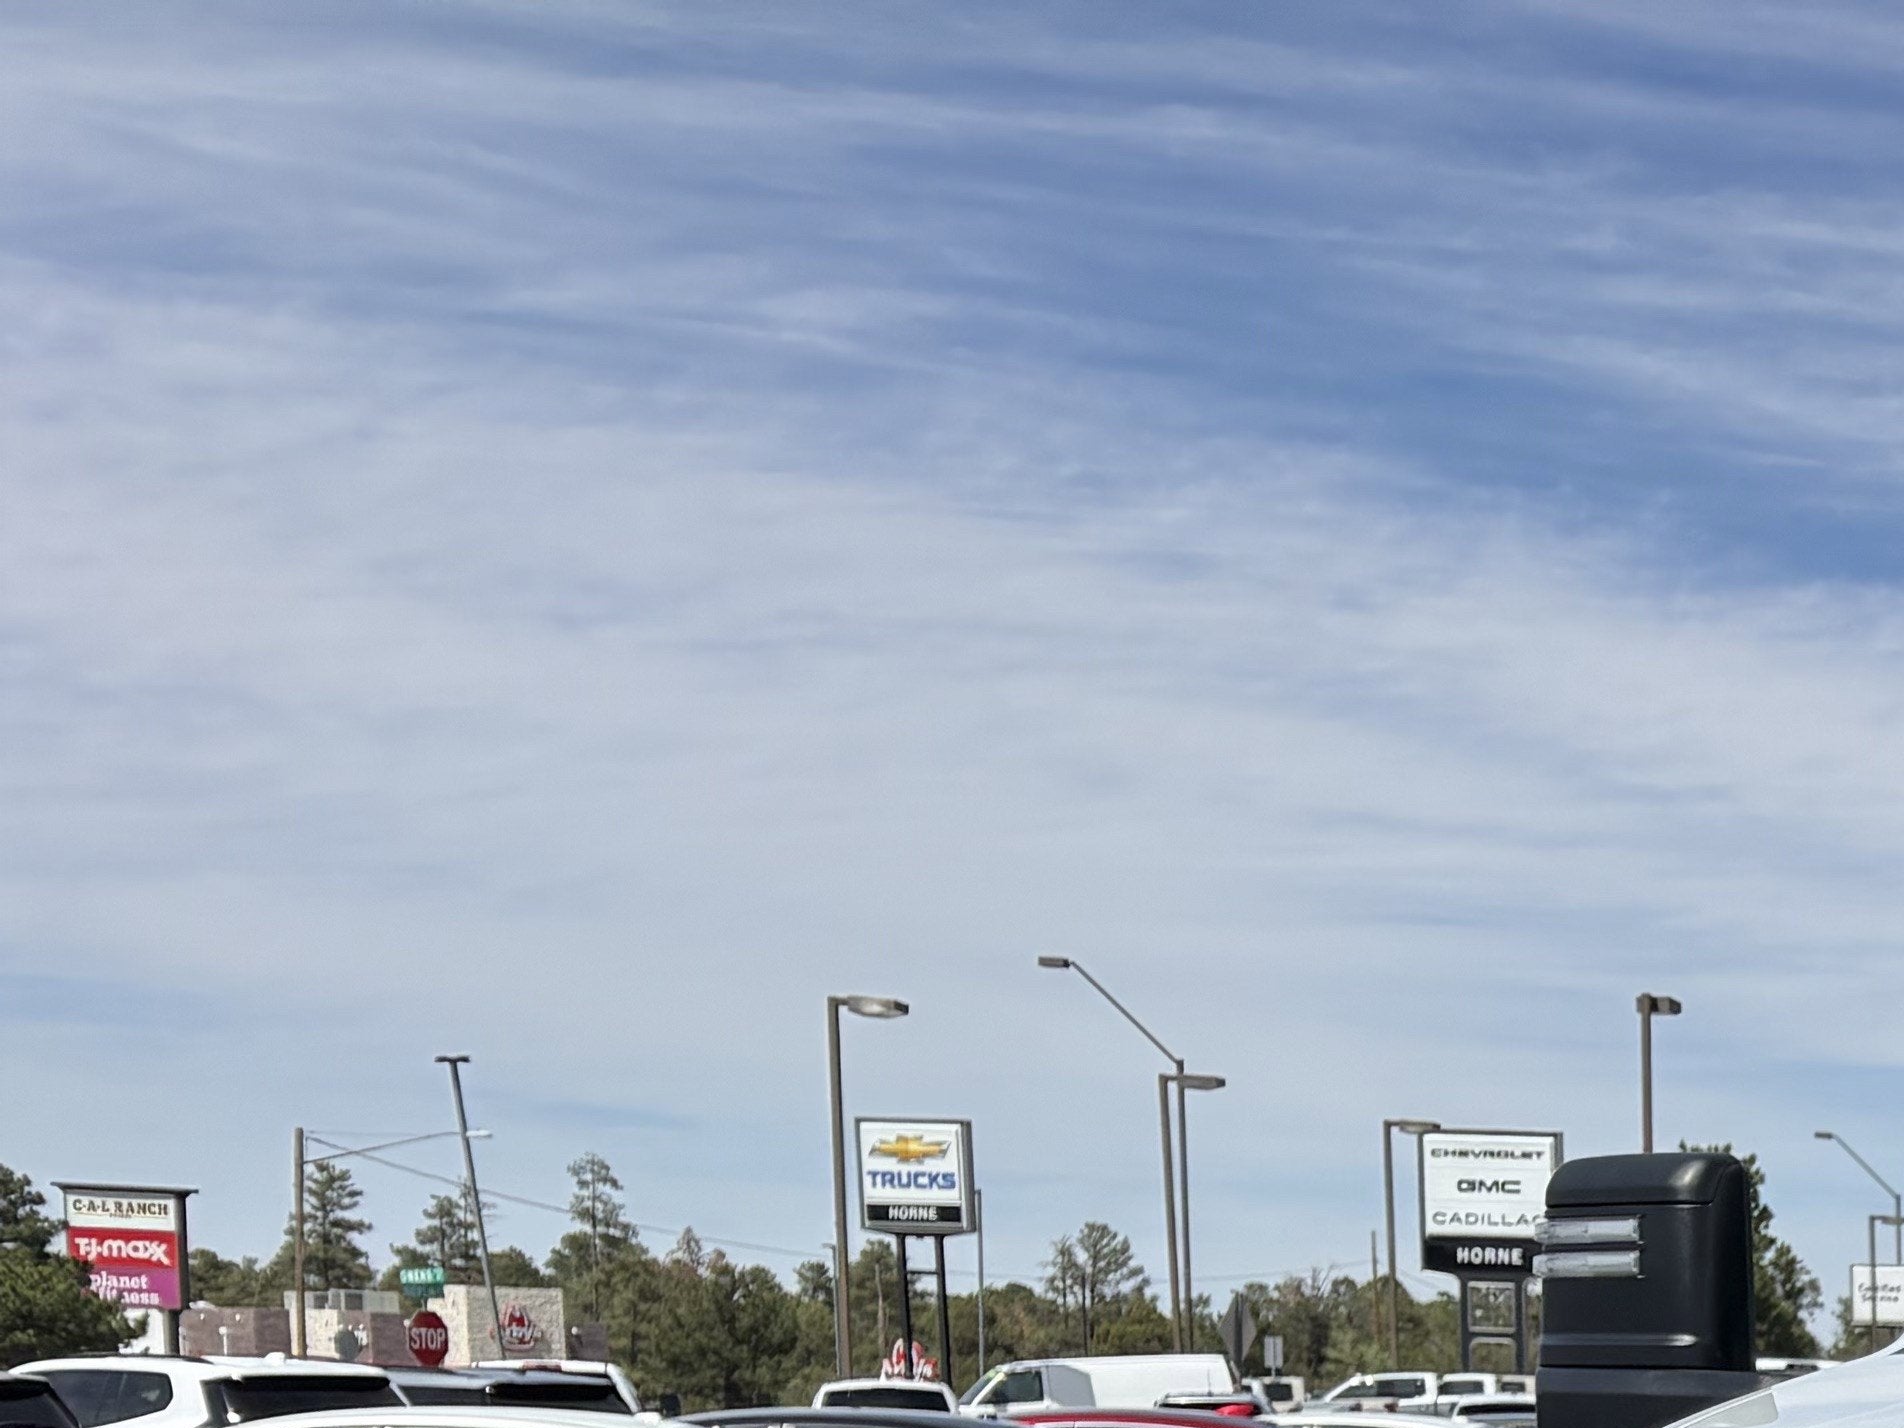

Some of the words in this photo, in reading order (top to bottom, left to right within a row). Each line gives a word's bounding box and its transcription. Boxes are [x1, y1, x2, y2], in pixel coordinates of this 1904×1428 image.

[1431, 1148, 1545, 1160] CHEVROLET
[866, 1169, 956, 1190] TRUCKS
[1456, 1178, 1522, 1195] GMC
[114, 1200, 169, 1216] RANCH
[888, 1205, 938, 1221] HORNE
[1456, 1246, 1524, 1266] HORNE
[89, 1270, 149, 1291] planet
[411, 1328, 446, 1351] STOP
